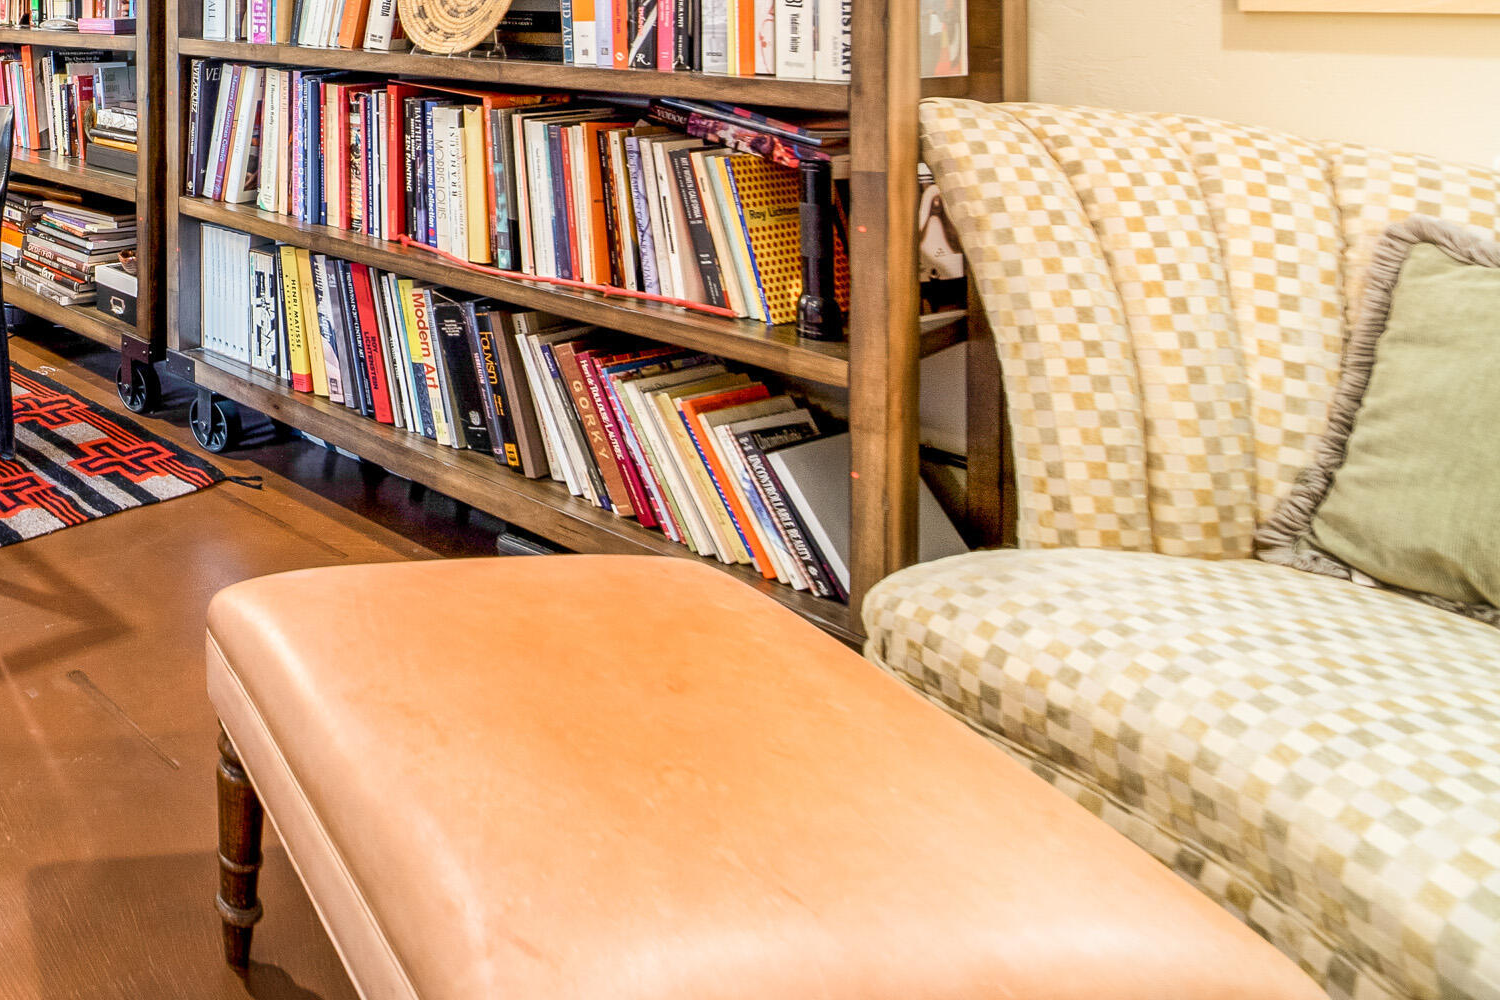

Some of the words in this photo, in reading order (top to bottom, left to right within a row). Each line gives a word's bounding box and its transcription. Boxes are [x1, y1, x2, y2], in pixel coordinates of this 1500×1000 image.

[563, 26, 572, 50] ART
[790, 14, 800, 34] Vladimir
[230, 75, 238, 100] Masters
[223, 108, 233, 138] American
[220, 139, 228, 162] Comics
[434, 140, 445, 182] MORRIS
[437, 186, 446, 219] LOUIS
[749, 209, 766, 221] Roy
[370, 336, 378, 352] ROY
[412, 293, 431, 357] Modern
[424, 363, 438, 389] Art
[364, 331, 378, 390] LICHTENSTEIN
[480, 331, 499, 384] Fauvism
[580, 360, 592, 377] Henri
[572, 380, 610, 459] GORKY
[747, 454, 796, 528] UNCONTROLLABLE
[786, 529, 813, 561] BEAUTY
